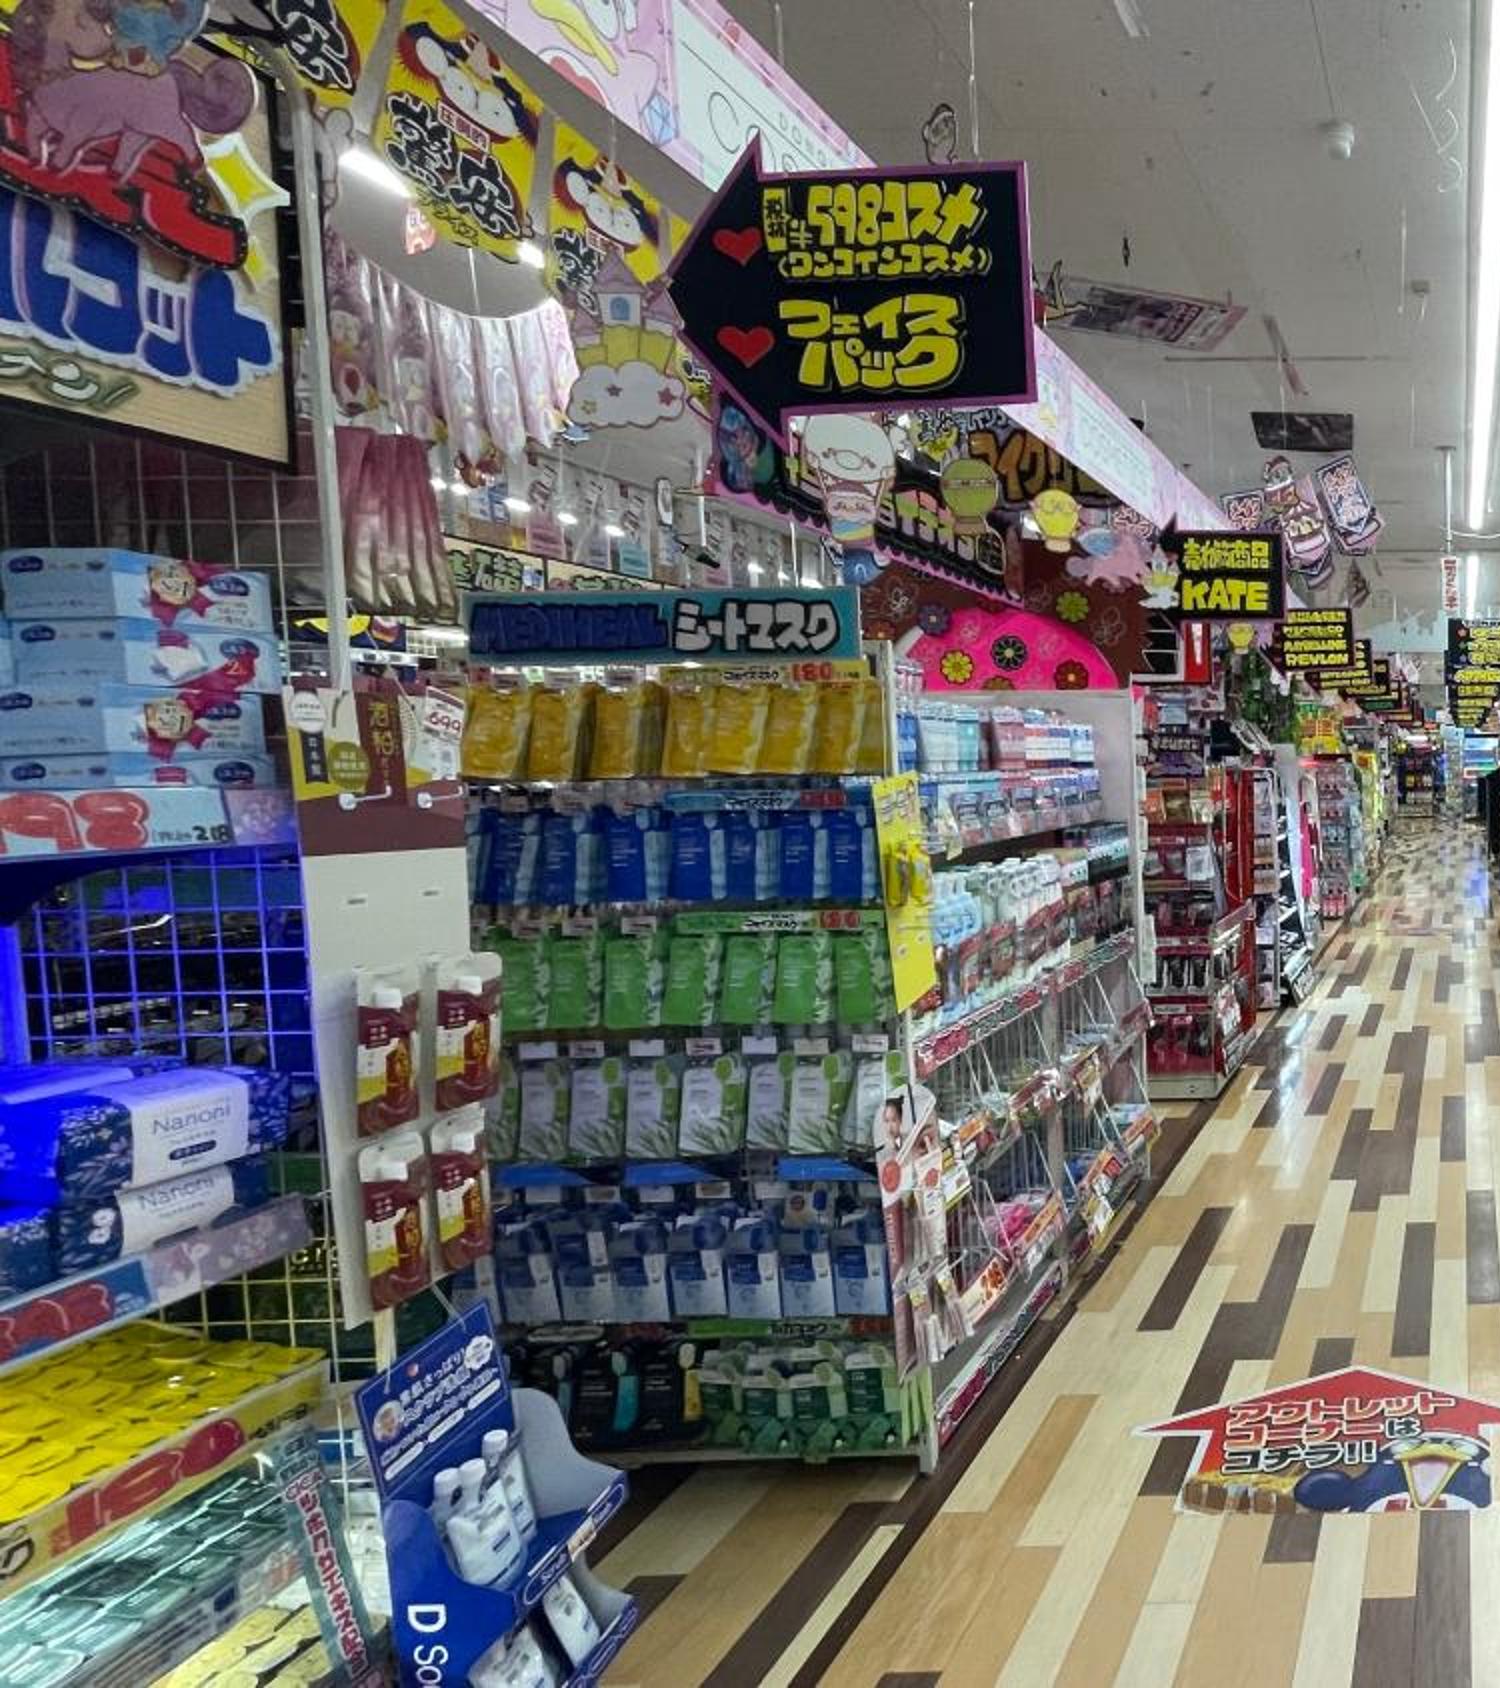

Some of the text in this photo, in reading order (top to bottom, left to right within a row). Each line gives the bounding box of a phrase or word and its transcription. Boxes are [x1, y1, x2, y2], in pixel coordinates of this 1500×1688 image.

[778, 245, 992, 278] (ワンコインコスメ)
[780, 294, 962, 339] フェイス
[800, 336, 961, 388] パック
[1182, 579, 1269, 611] KATE
[673, 600, 839, 653] シートマスク
[1285, 653, 1348, 667] REVLON
[152, 1107, 231, 1136] Nanoni
[139, 1175, 215, 1211] Nanoni
[1229, 1391, 1456, 1427] アウトレット
[1224, 1419, 1421, 1450] コーナーは
[1220, 1440, 1377, 1476] コチラ!!
[408, 1604, 447, 1633] D
